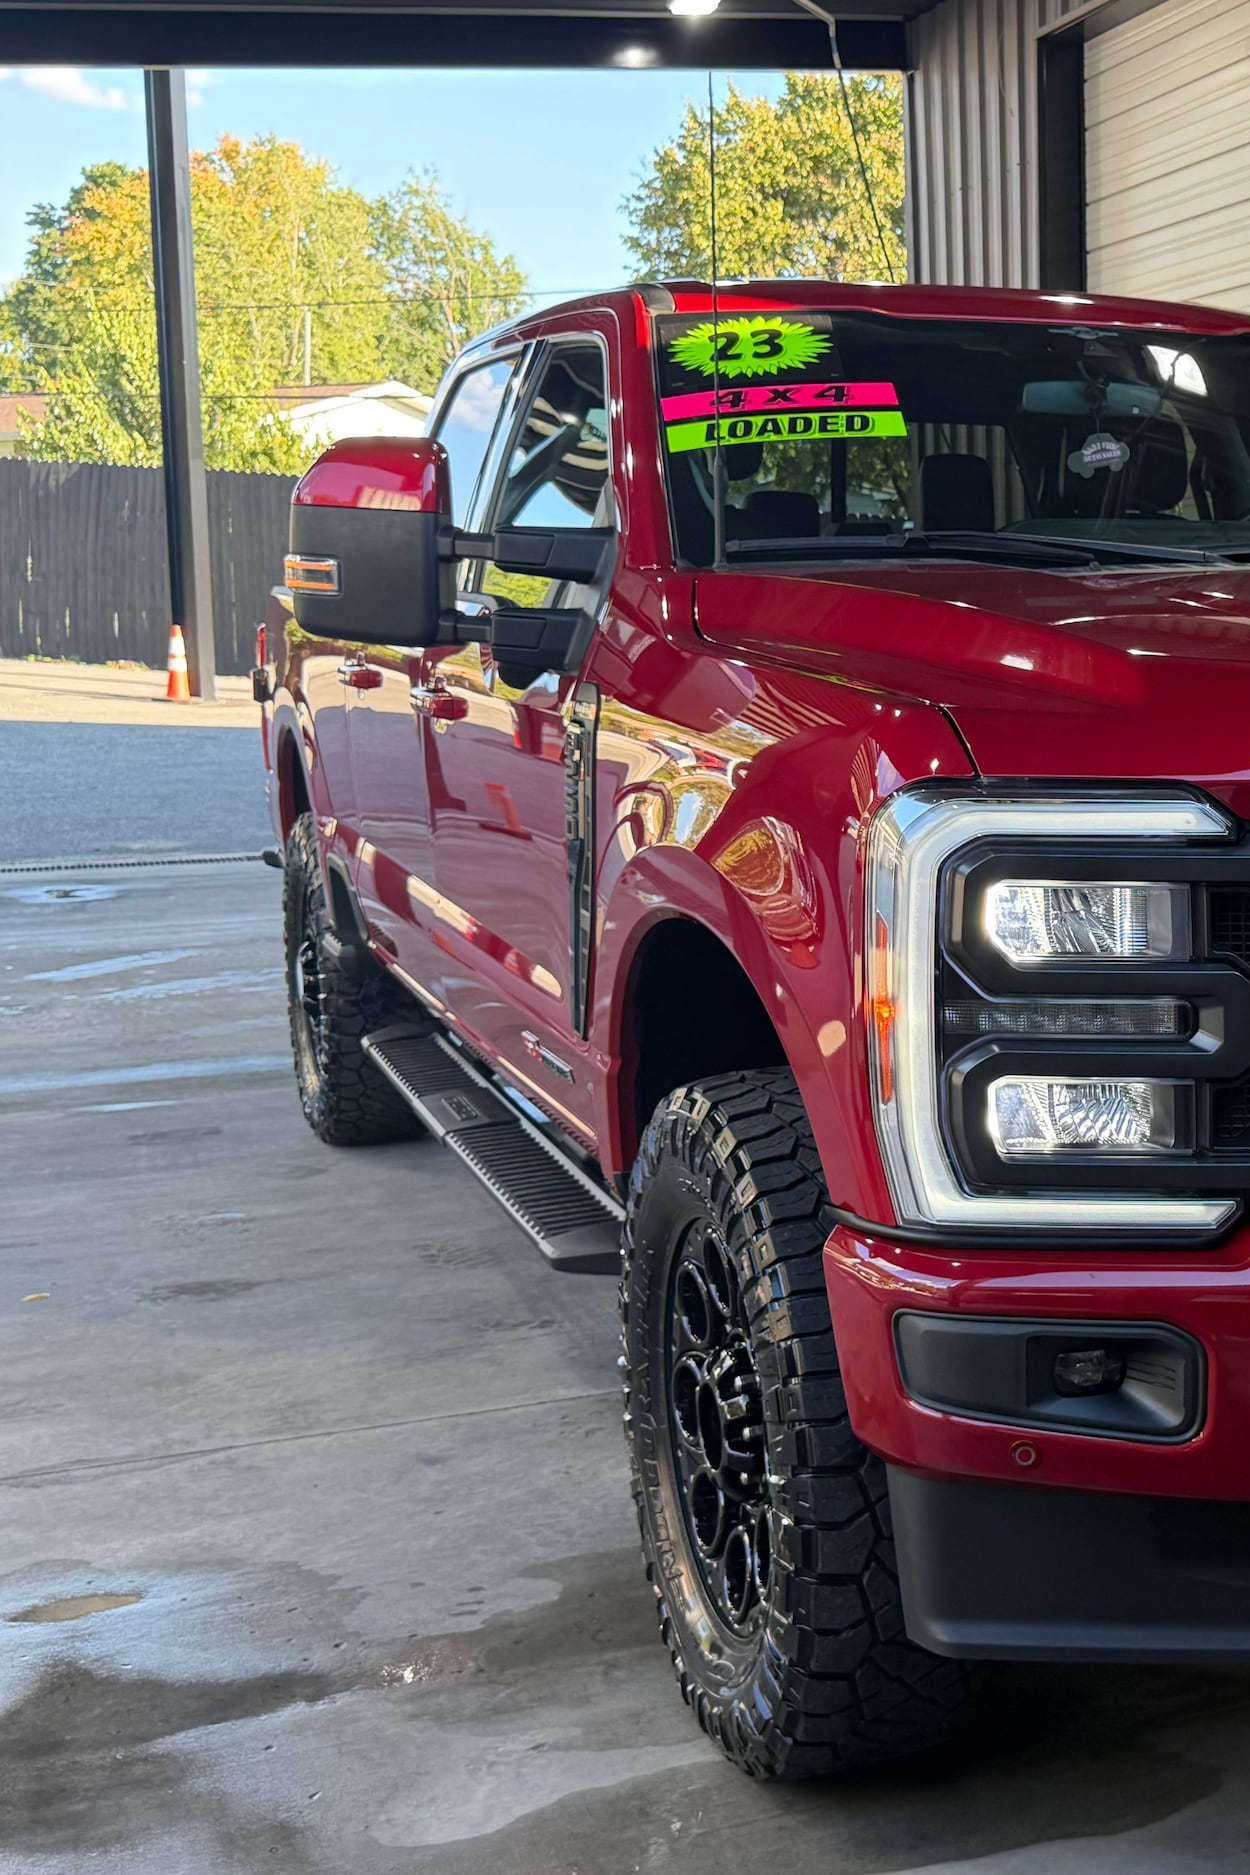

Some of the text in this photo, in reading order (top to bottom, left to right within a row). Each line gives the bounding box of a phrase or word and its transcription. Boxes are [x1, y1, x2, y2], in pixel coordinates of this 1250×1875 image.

[708, 329, 784, 363] 23
[709, 389, 747, 409] 4
[814, 385, 850, 404] 4
[705, 414, 873, 443] LOADED
